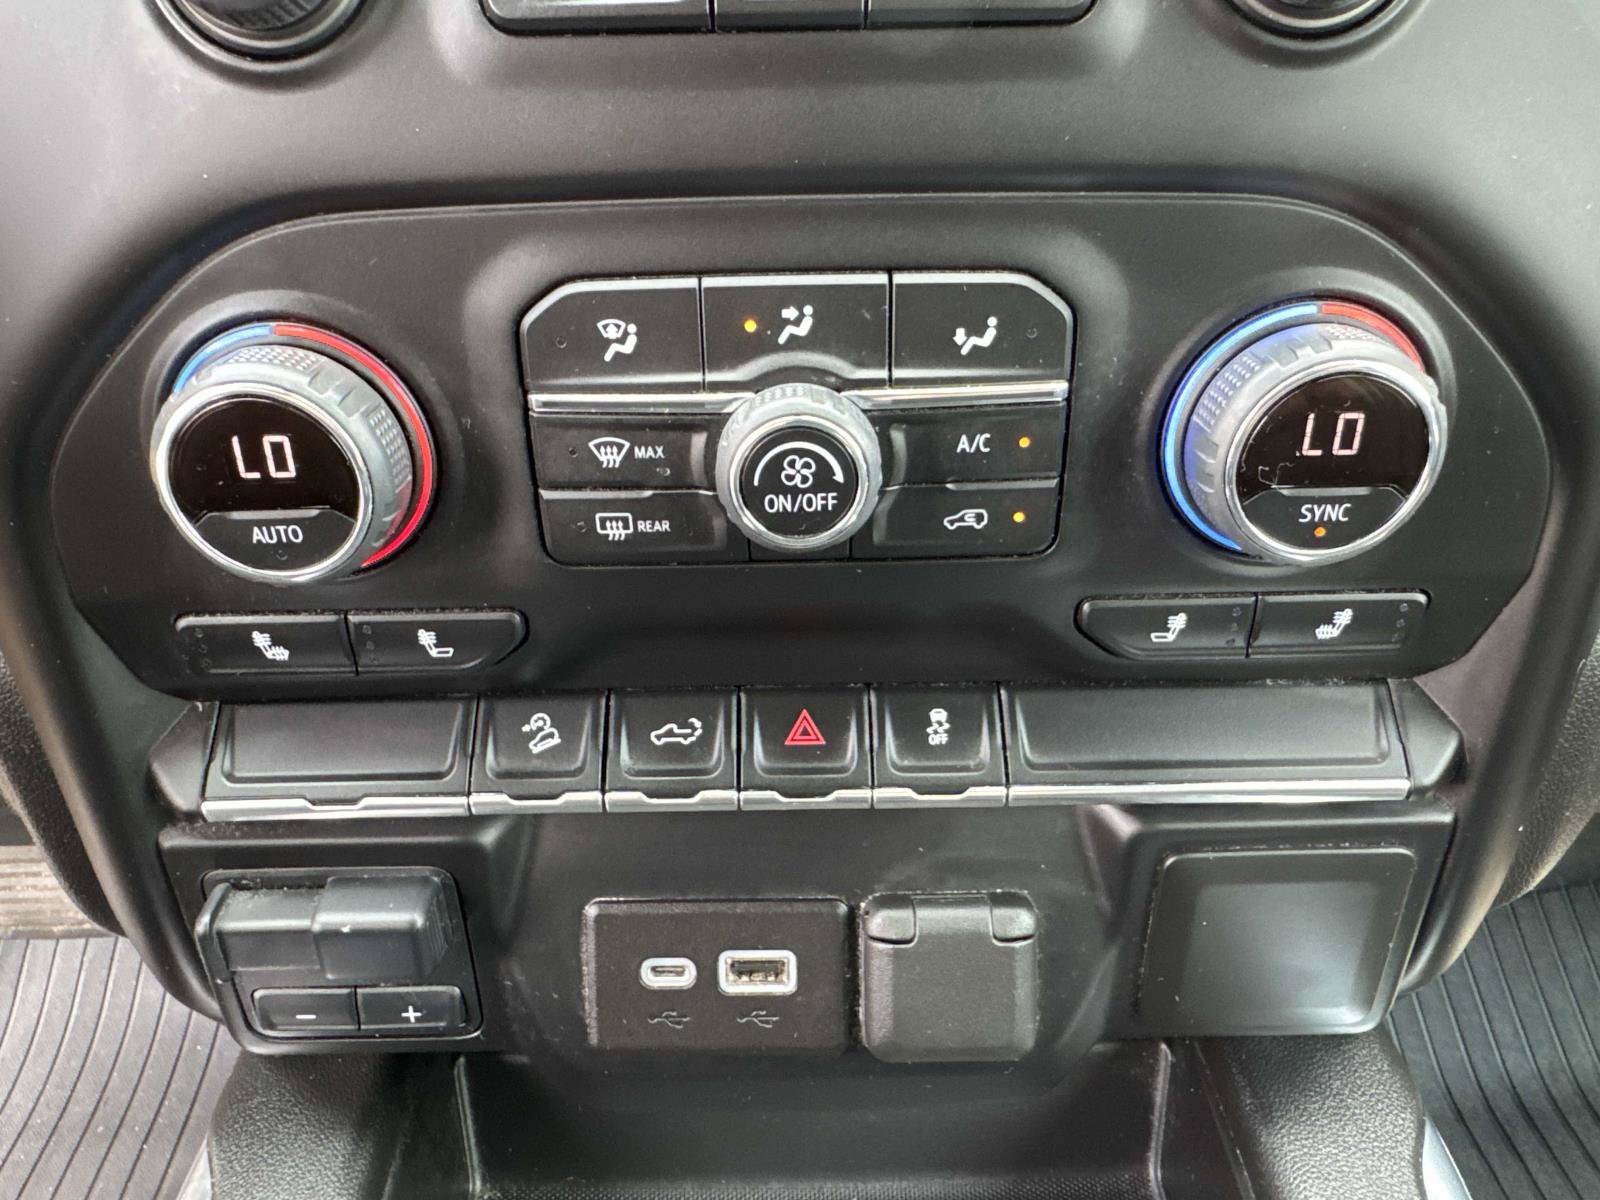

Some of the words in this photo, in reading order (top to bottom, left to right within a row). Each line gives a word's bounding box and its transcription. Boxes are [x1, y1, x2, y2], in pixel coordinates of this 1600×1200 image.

[955, 432, 990, 453] A/C
[1301, 412, 1367, 456] LO
[231, 434, 297, 479] LO
[634, 445, 665, 459] MAX
[763, 492, 838, 513] ON/OFF
[1299, 503, 1352, 522] SYNC
[252, 524, 304, 543] AUTO
[637, 520, 671, 533] REAR
[928, 733, 949, 746] OFF
